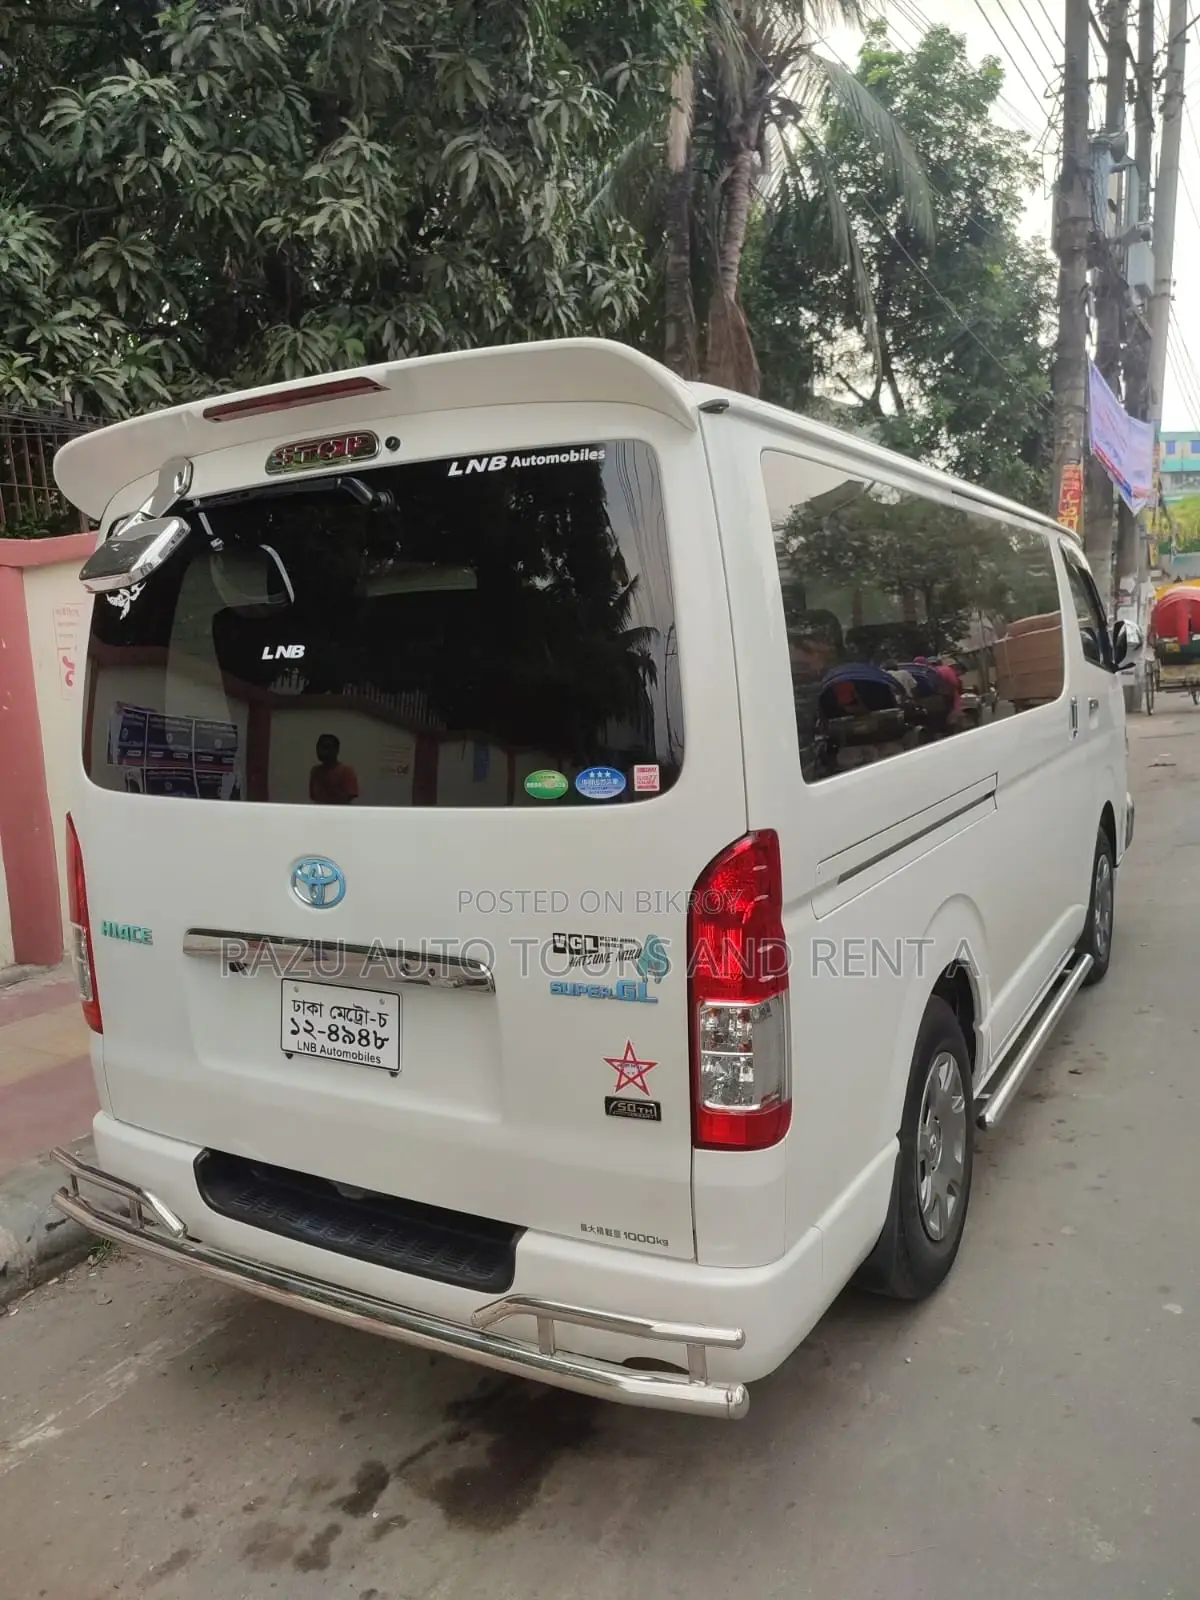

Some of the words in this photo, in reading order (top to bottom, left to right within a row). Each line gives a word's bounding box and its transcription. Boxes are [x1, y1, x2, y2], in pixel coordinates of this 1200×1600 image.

[274, 435, 370, 465] STOP
[447, 455, 509, 477] LNB
[510, 448, 606, 468] Automobiles
[261, 644, 306, 660] LNB
[101, 919, 154, 946] HIACE
[550, 981, 614, 999] SUPER
[615, 979, 659, 1004] GL
[291, 1000, 324, 1018] ঢাকা
[290, 1017, 390, 1050] ১২-৪৯৪৮
[297, 1040, 317, 1053] LNB
[319, 1044, 382, 1065] Automobiles
[623, 1231, 669, 1247] 1000kg
